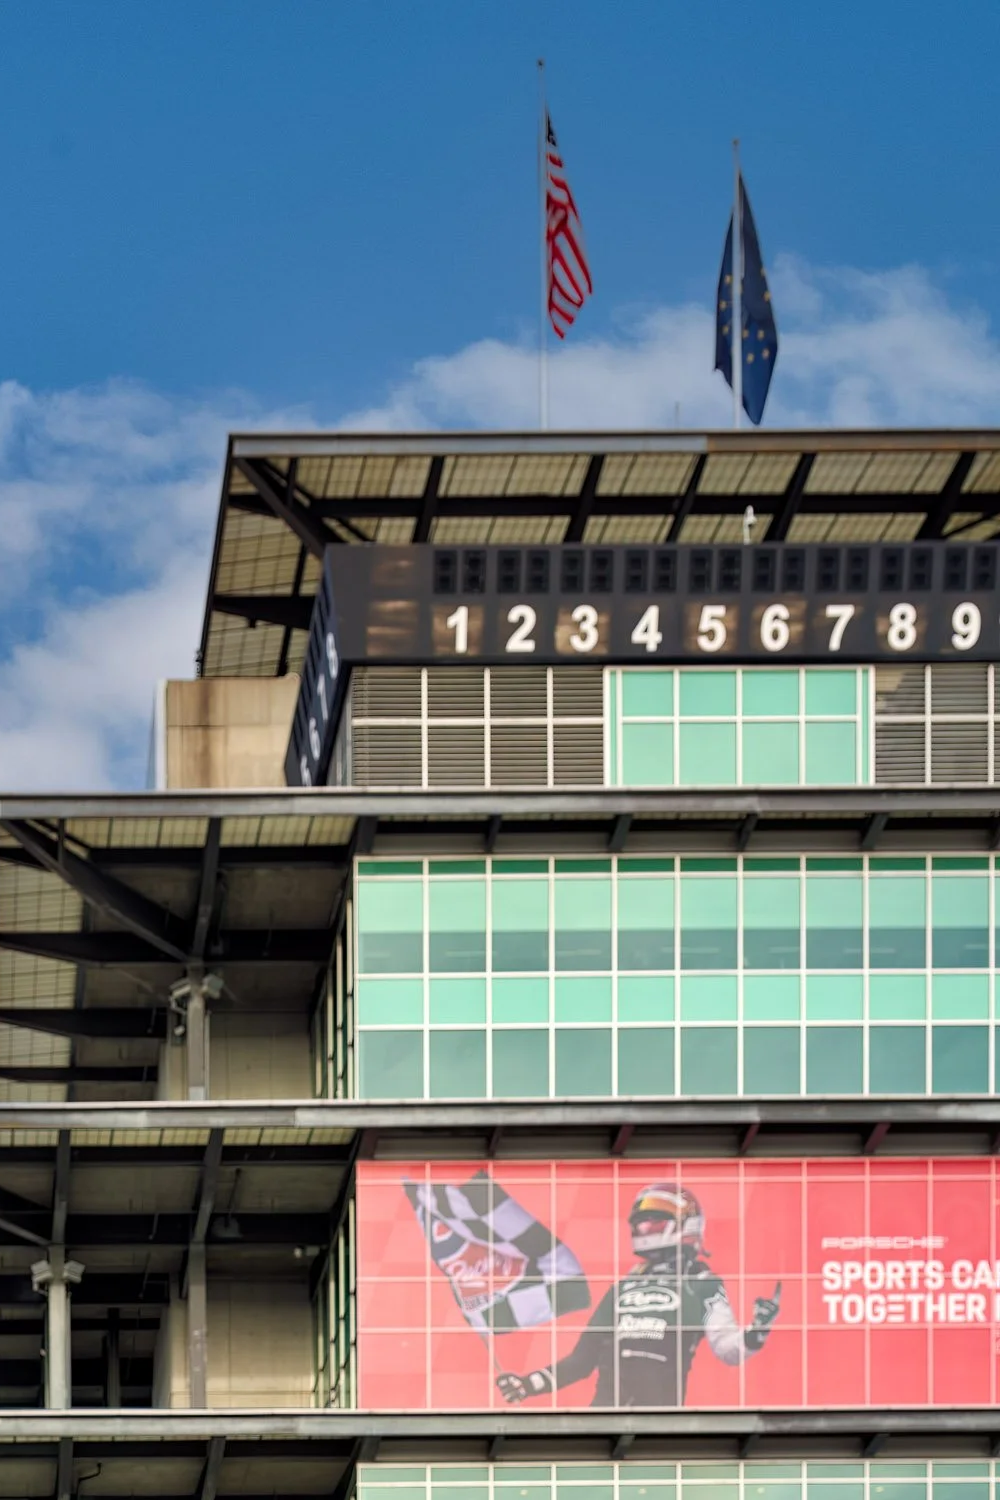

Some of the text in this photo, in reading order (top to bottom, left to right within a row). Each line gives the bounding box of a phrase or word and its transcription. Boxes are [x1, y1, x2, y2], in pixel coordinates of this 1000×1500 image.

[446, 601, 981, 653] 1 2 3 4 5 6 7 8 9
[821, 1236, 945, 1249] PORSCHE
[822, 1260, 1000, 1290] SPORTS CA
[822, 1293, 987, 1324] TOGETHER
